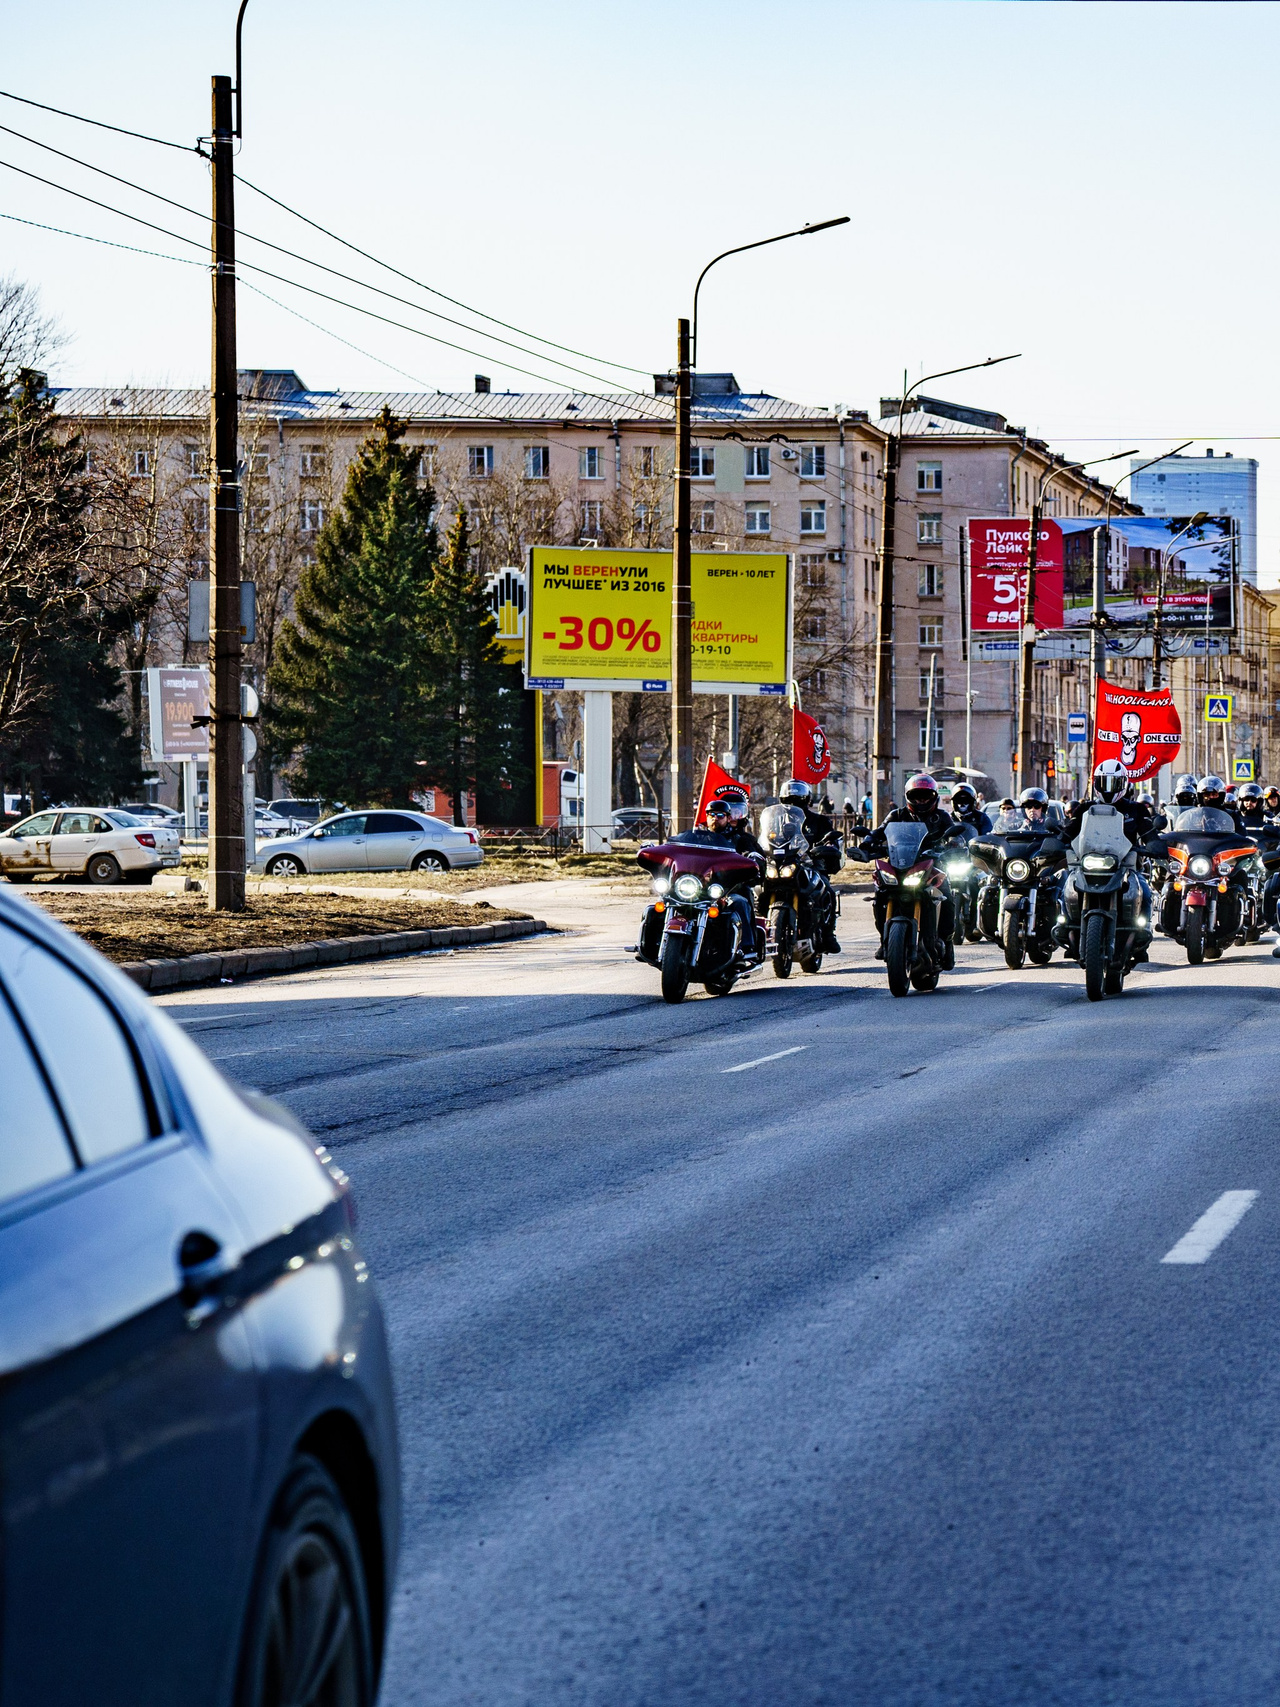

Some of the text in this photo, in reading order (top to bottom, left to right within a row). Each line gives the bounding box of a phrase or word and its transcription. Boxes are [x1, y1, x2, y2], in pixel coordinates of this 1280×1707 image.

[985, 542, 1023, 554] Лейк
[543, 564, 648, 578] МЫ ВЕРЕНУЛИ
[707, 568, 776, 579] ВЕРЕН 10 ЛЕТ
[610, 581, 630, 591] ИЗ
[633, 580, 666, 592] 2016
[691, 620, 722, 631] ИДКИ
[543, 616, 661, 653] -30%
[693, 633, 758, 644] КВАРТИРЫ
[691, 645, 731, 655] 0-19-10
[1113, 694, 1170, 706] HOOLIGANS
[1146, 734, 1161, 742] ONE
